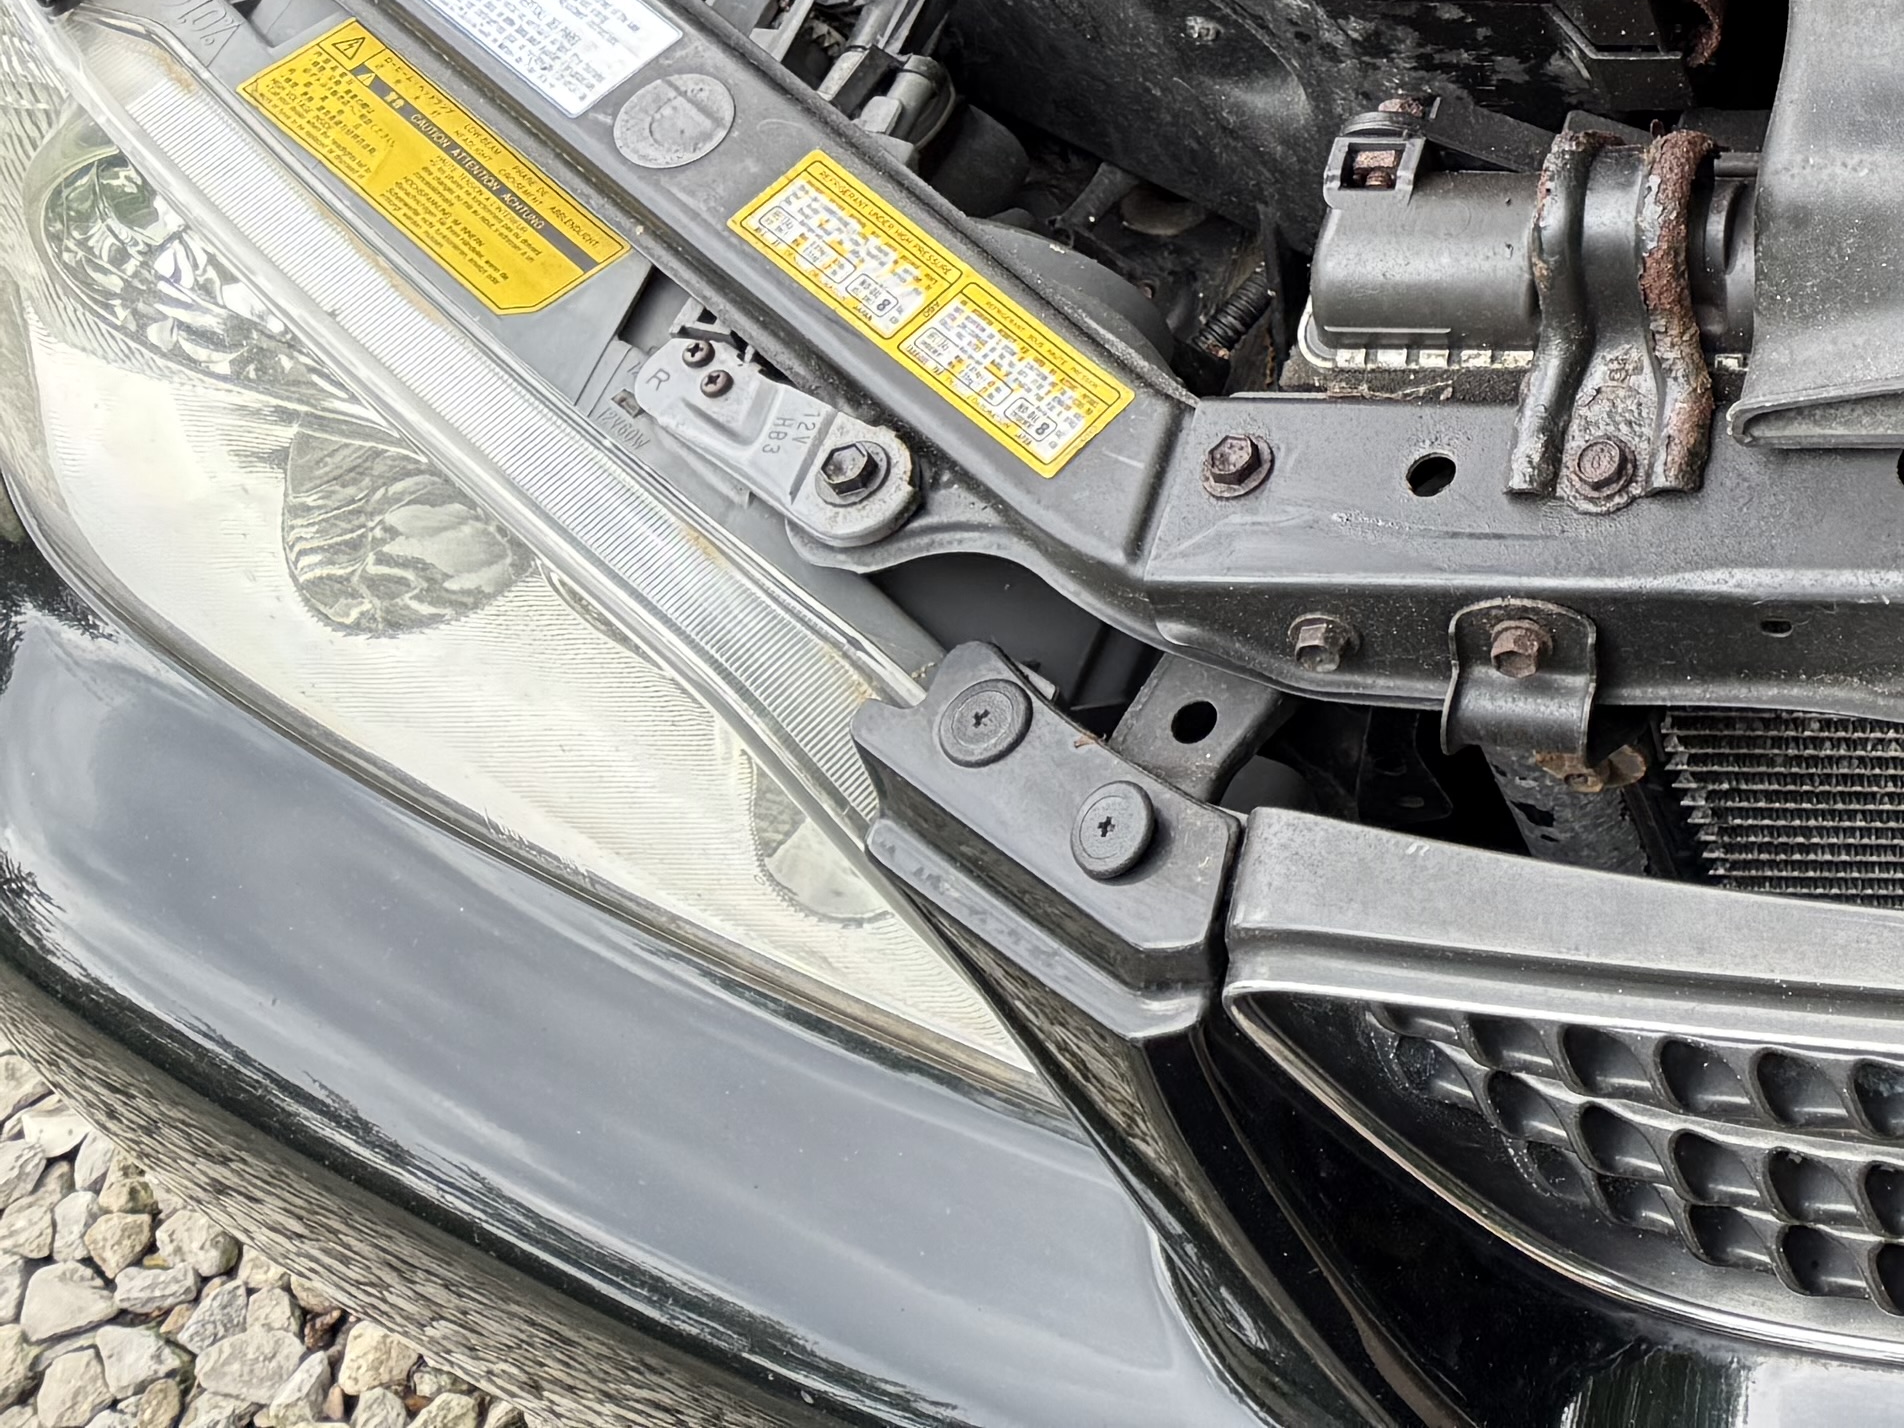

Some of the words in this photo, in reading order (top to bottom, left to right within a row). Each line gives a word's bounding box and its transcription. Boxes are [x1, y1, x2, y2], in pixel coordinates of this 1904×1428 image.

[406, 111, 455, 149] CAUTION
[446, 146, 504, 192] ATTENTION
[497, 190, 549, 231] ACHTUNG
[817, 169, 868, 211] REFRIGERANT
[867, 207, 895, 231] UNDER
[892, 227, 914, 245] HIGH
[910, 241, 952, 276] PRESSURE
[646, 367, 671, 392] R
[596, 407, 651, 450] 12V60W
[761, 416, 795, 456] HB3
[790, 410, 821, 445] 12V
[1033, 420, 1052, 438] 8
